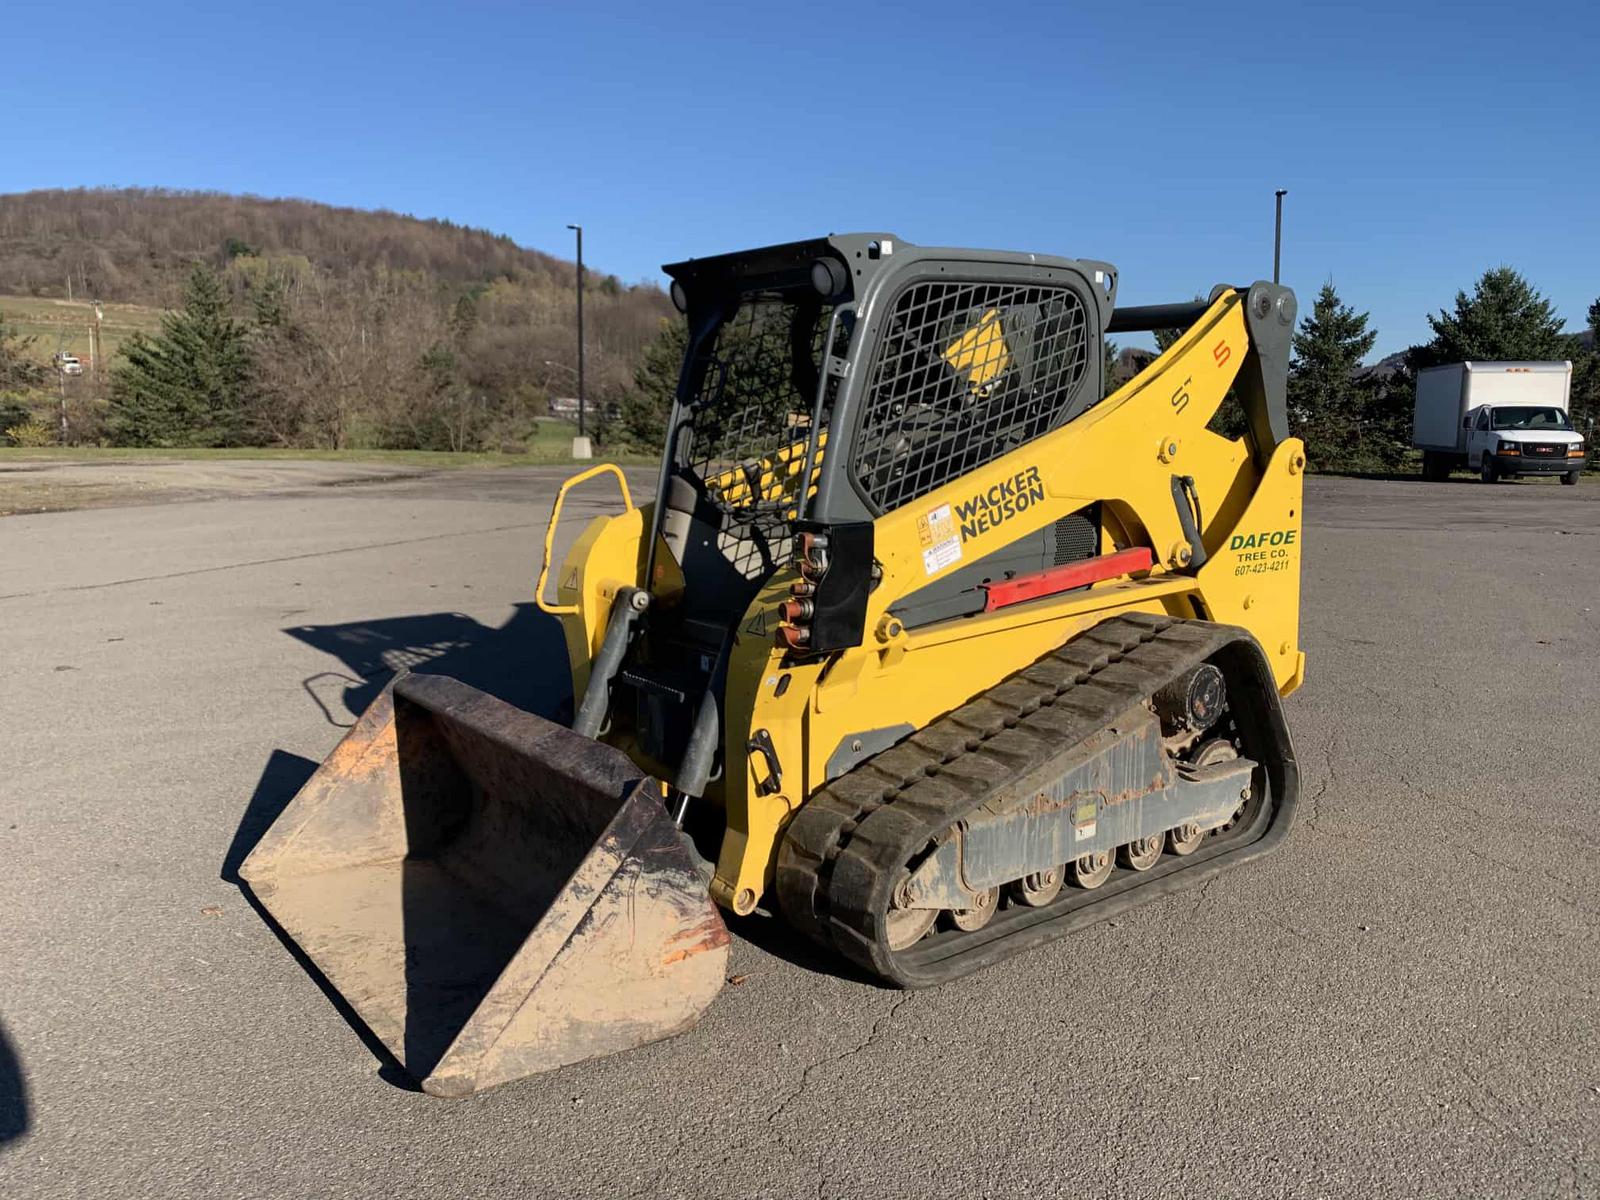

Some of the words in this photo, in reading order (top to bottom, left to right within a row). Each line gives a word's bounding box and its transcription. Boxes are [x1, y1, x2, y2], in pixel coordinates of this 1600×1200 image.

[1213, 339, 1231, 368] 5
[954, 466, 1041, 522] WACKER
[960, 483, 1045, 543] NEUSON
[1230, 530, 1297, 550] DAFOE
[1238, 551, 1267, 562] TREE
[1270, 549, 1288, 559] CO.
[1234, 560, 1289, 576] 607-423-4211
